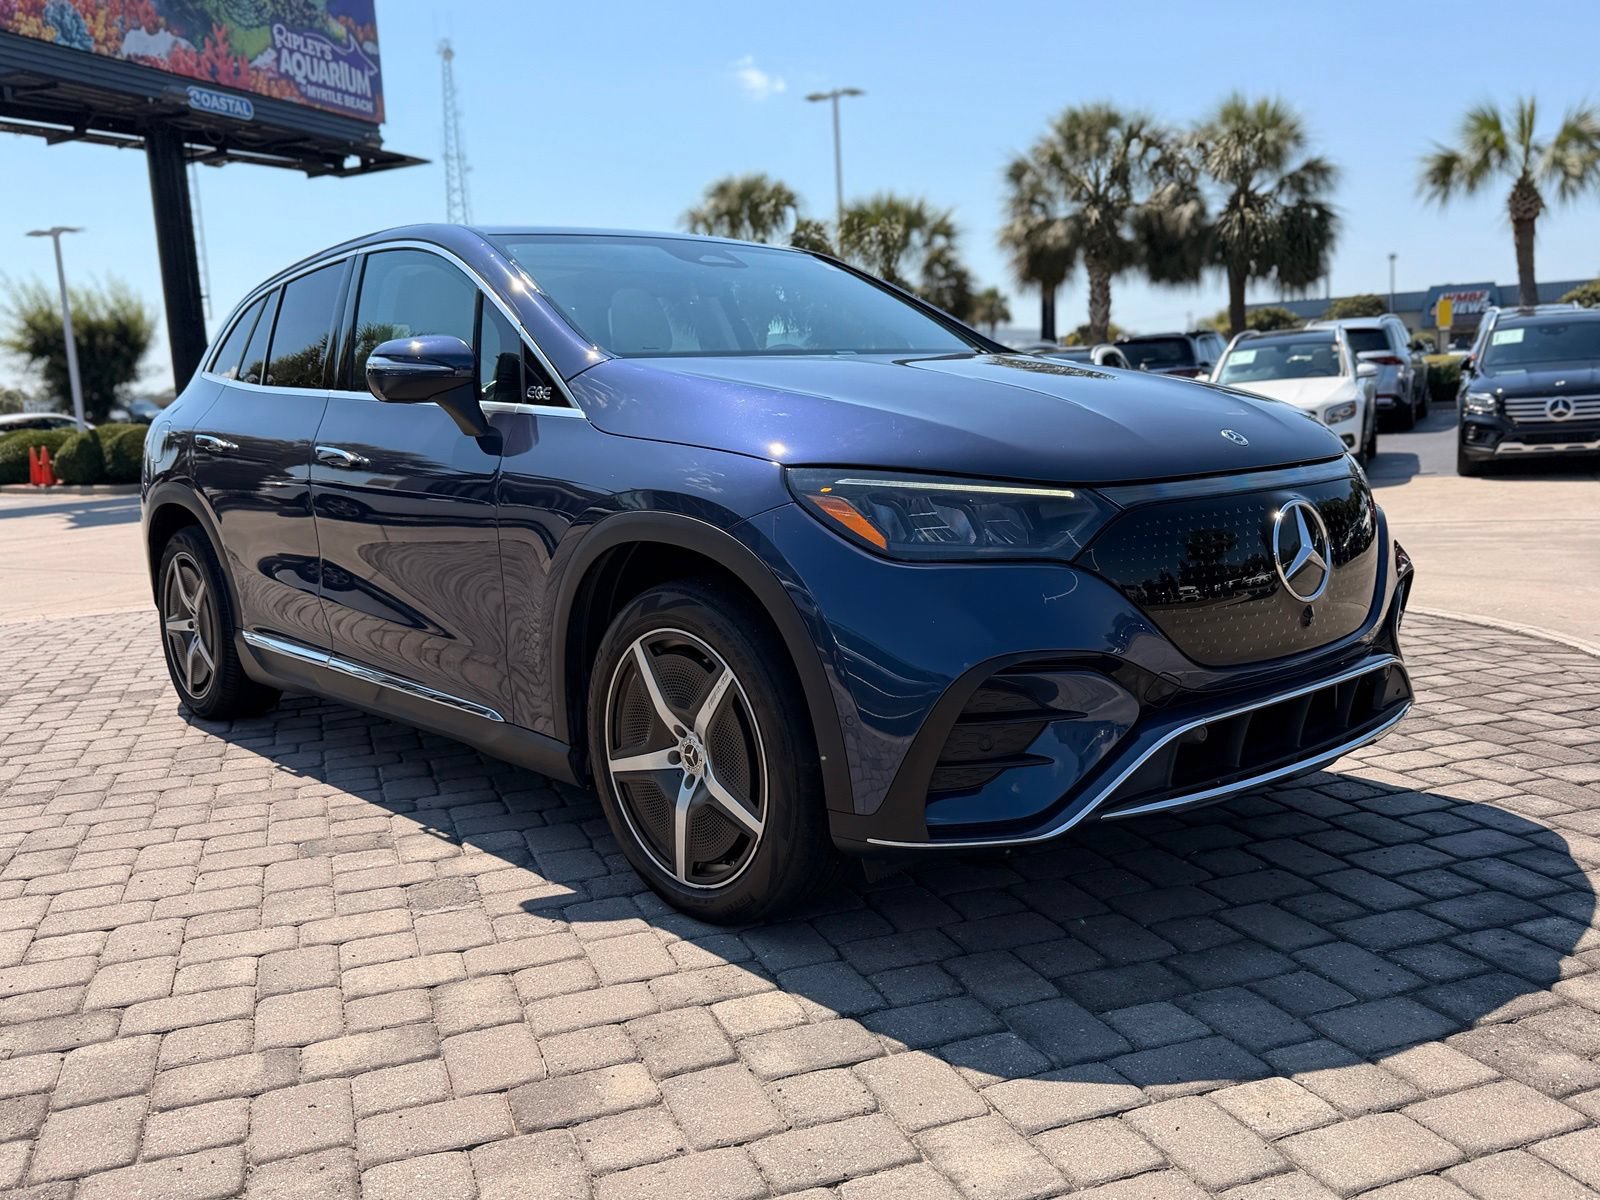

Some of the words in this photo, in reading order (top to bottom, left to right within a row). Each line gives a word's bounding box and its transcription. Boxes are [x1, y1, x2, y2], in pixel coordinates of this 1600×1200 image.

[273, 23, 333, 60] RIPLEY'S
[280, 48, 372, 98] AQUARIUM
[188, 90, 250, 115] COASTAL
[307, 84, 342, 105] MYRTLE
[343, 95, 373, 113] BEACH
[527, 386, 551, 400] EQE
